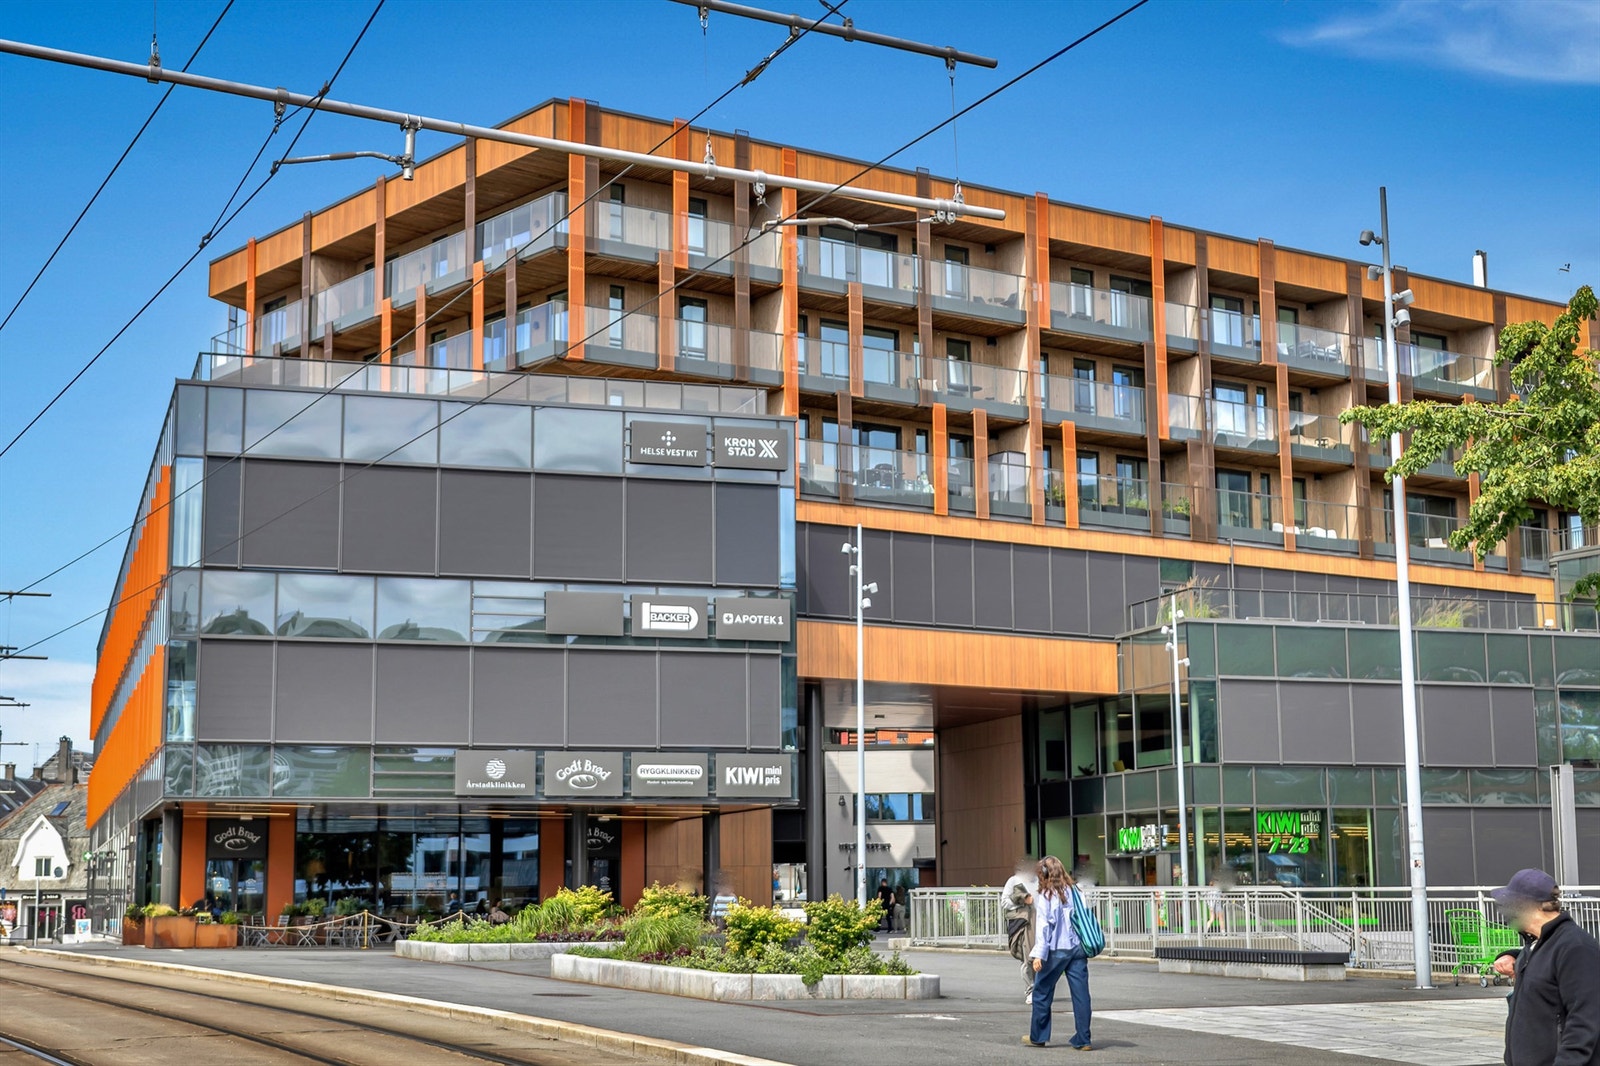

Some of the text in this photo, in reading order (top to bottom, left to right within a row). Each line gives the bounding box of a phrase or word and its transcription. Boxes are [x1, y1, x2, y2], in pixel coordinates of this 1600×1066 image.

[724, 437, 756, 448] KRON
[640, 447, 698, 458] HELSE VEST IKT
[727, 447, 756, 457] STAD
[650, 612, 691, 623] BACKER
[734, 614, 784, 625] APOTEK 1
[556, 759, 612, 780] Godt Brød
[639, 767, 701, 776] RYGGKLINIKKEN
[765, 765, 782, 776] mini
[725, 766, 764, 785] KIWI
[466, 779, 526, 788] Årstadklinikken
[765, 776, 781, 787] pris
[1300, 810, 1321, 822] mini
[1257, 811, 1301, 834] KIWI
[1300, 821, 1320, 836] pris
[214, 826, 236, 843] Godt
[1119, 826, 1143, 851] KIWI
[1269, 837, 1310, 854] 7-23
